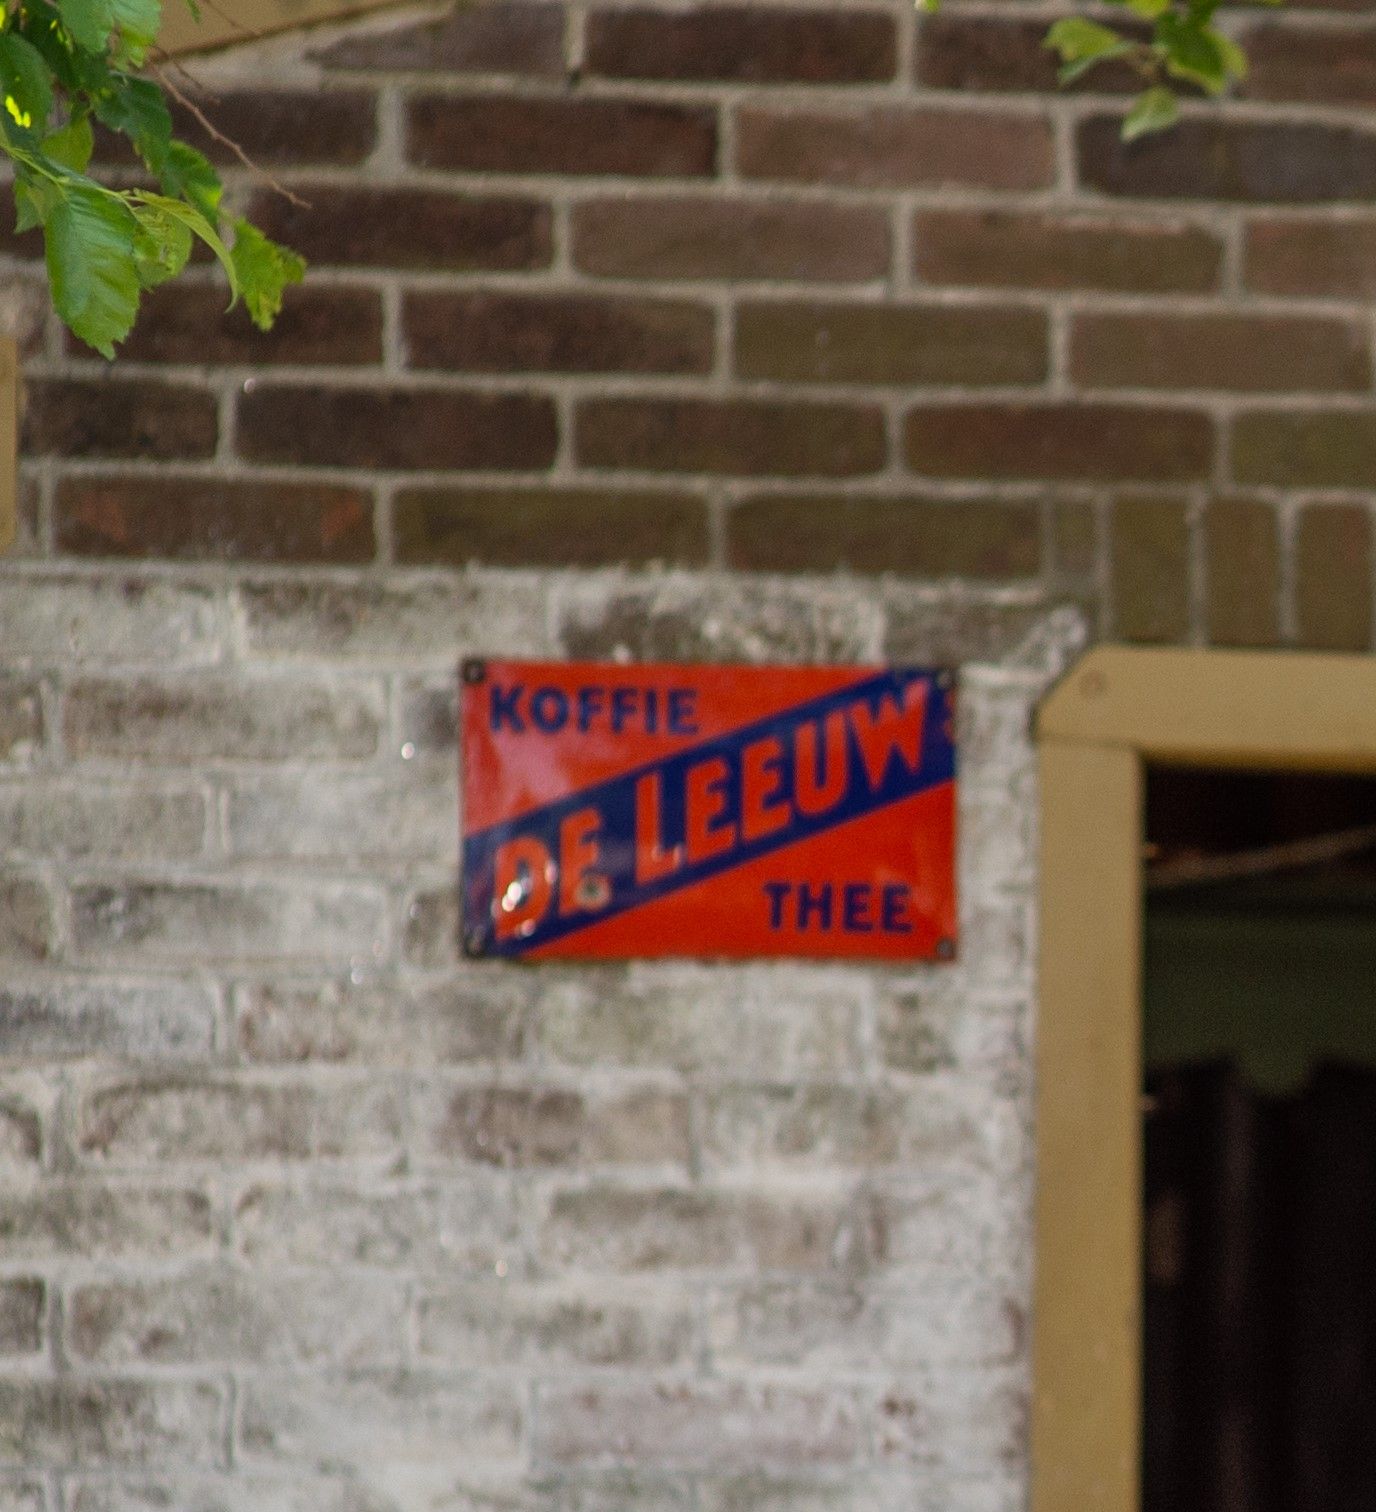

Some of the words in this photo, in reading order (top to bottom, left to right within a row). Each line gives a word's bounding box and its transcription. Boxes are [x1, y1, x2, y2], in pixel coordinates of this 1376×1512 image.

[488, 686, 700, 735] KOFFIE
[492, 809, 610, 940] DE
[634, 677, 928, 886] LEEUW
[762, 881, 914, 934] THEE
